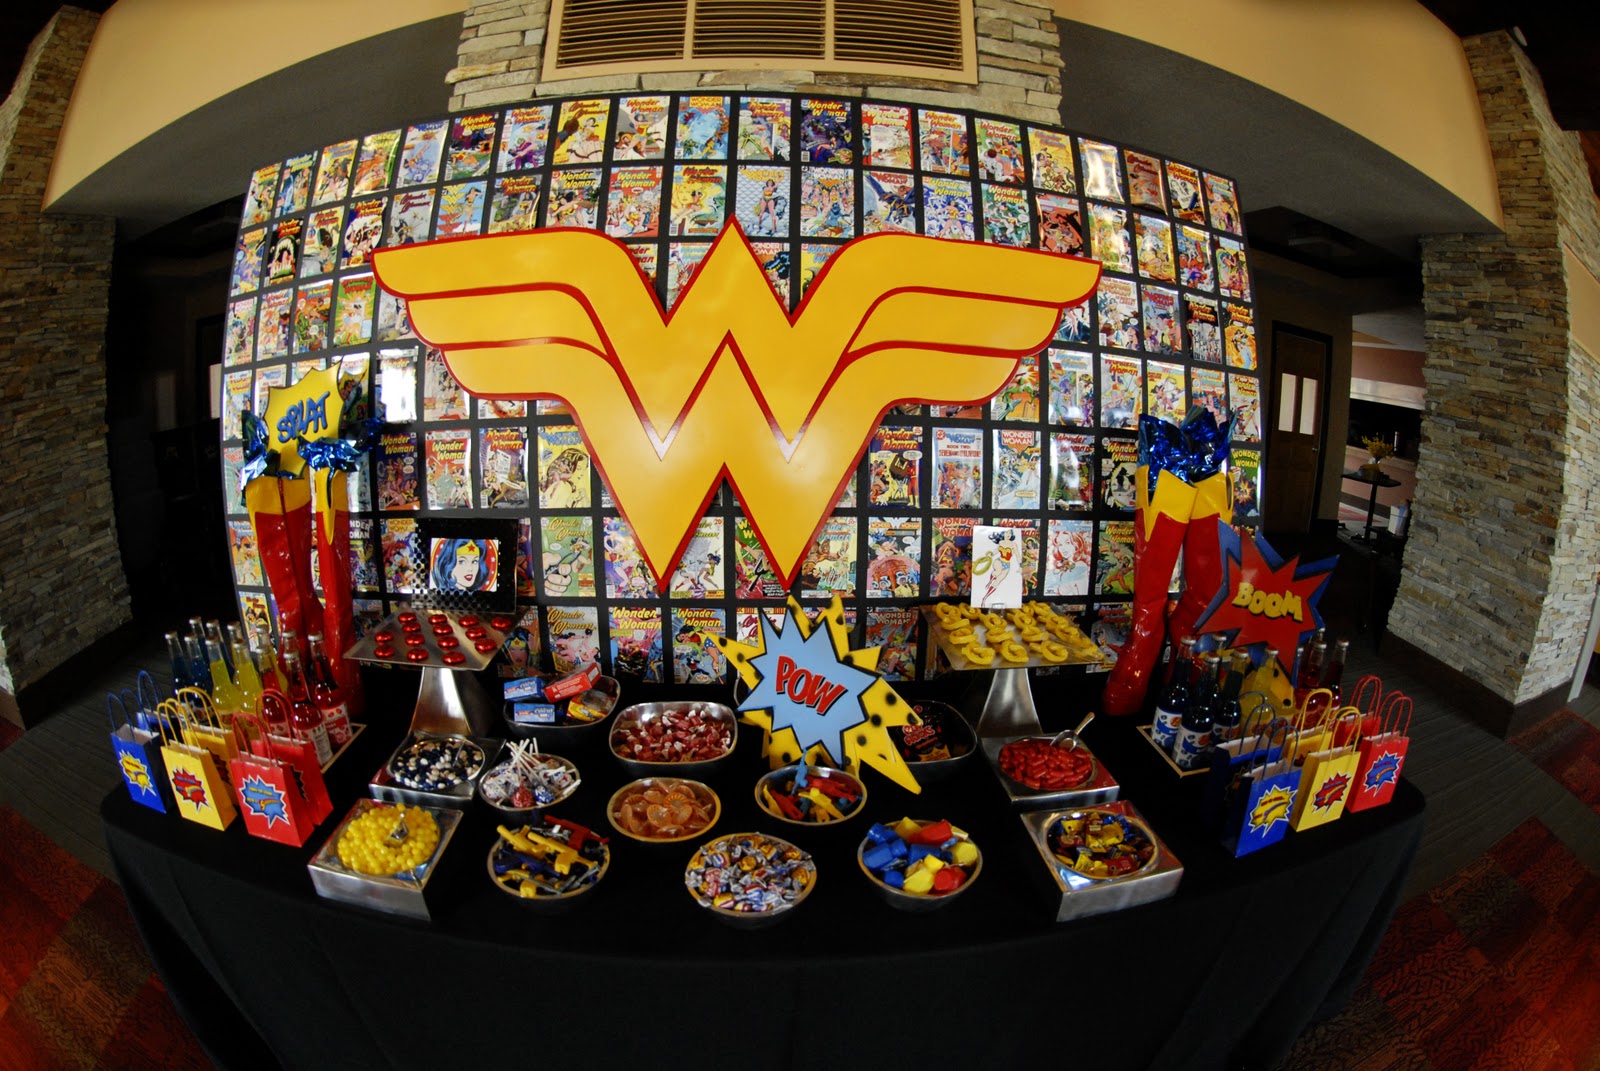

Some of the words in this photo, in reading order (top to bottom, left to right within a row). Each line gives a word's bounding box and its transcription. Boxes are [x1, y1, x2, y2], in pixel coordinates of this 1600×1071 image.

[627, 98, 659, 108] Wonder
[806, 100, 842, 110] Wonder
[511, 107, 544, 119] Wonder
[631, 105, 665, 114] Woman
[812, 109, 848, 117] Wman
[461, 114, 493, 127] Wonder
[514, 114, 546, 124] Woman
[925, 111, 957, 122] Wonder
[464, 121, 495, 131] Woman
[929, 119, 962, 129] Woman
[980, 122, 1013, 133] Wonder
[985, 130, 1018, 141] Woman
[559, 171, 593, 180] Wonder
[617, 171, 651, 181] Wonder
[683, 166, 718, 176] Wonder
[501, 176, 534, 187] Wonder
[563, 178, 598, 188] Woman
[621, 179, 655, 188] Woman
[928, 178, 965, 188] Wonder
[504, 184, 537, 195] Woman
[934, 188, 970, 198] Woman
[988, 184, 1020, 195] Wonder
[993, 193, 1025, 204] Woman
[277, 390, 331, 443] SPLAT
[381, 433, 411, 446] Wonder
[485, 429, 519, 442] Wonder
[876, 428, 914, 440] Wonder
[1002, 430, 1033, 438] WONDER
[385, 443, 415, 455] Woman
[432, 441, 465, 451] Wonder
[490, 440, 524, 451] Woman
[881, 438, 919, 450] Woman
[1107, 441, 1137, 453] Wonder
[1232, 450, 1259, 461] WONDER
[1235, 459, 1259, 468] WOMAN
[349, 520, 371, 531] NDER
[936, 517, 980, 528] WONDER
[349, 531, 370, 539] OMAN
[1105, 526, 1134, 536] Wonder
[1231, 581, 1304, 624] BOOM
[547, 607, 585, 623] Wonder
[612, 606, 658, 619] Wonder
[677, 608, 716, 618] Wonder
[619, 620, 662, 630] Woman
[684, 617, 722, 627] Woman
[551, 621, 594, 635] Woman
[775, 655, 848, 717] POW
